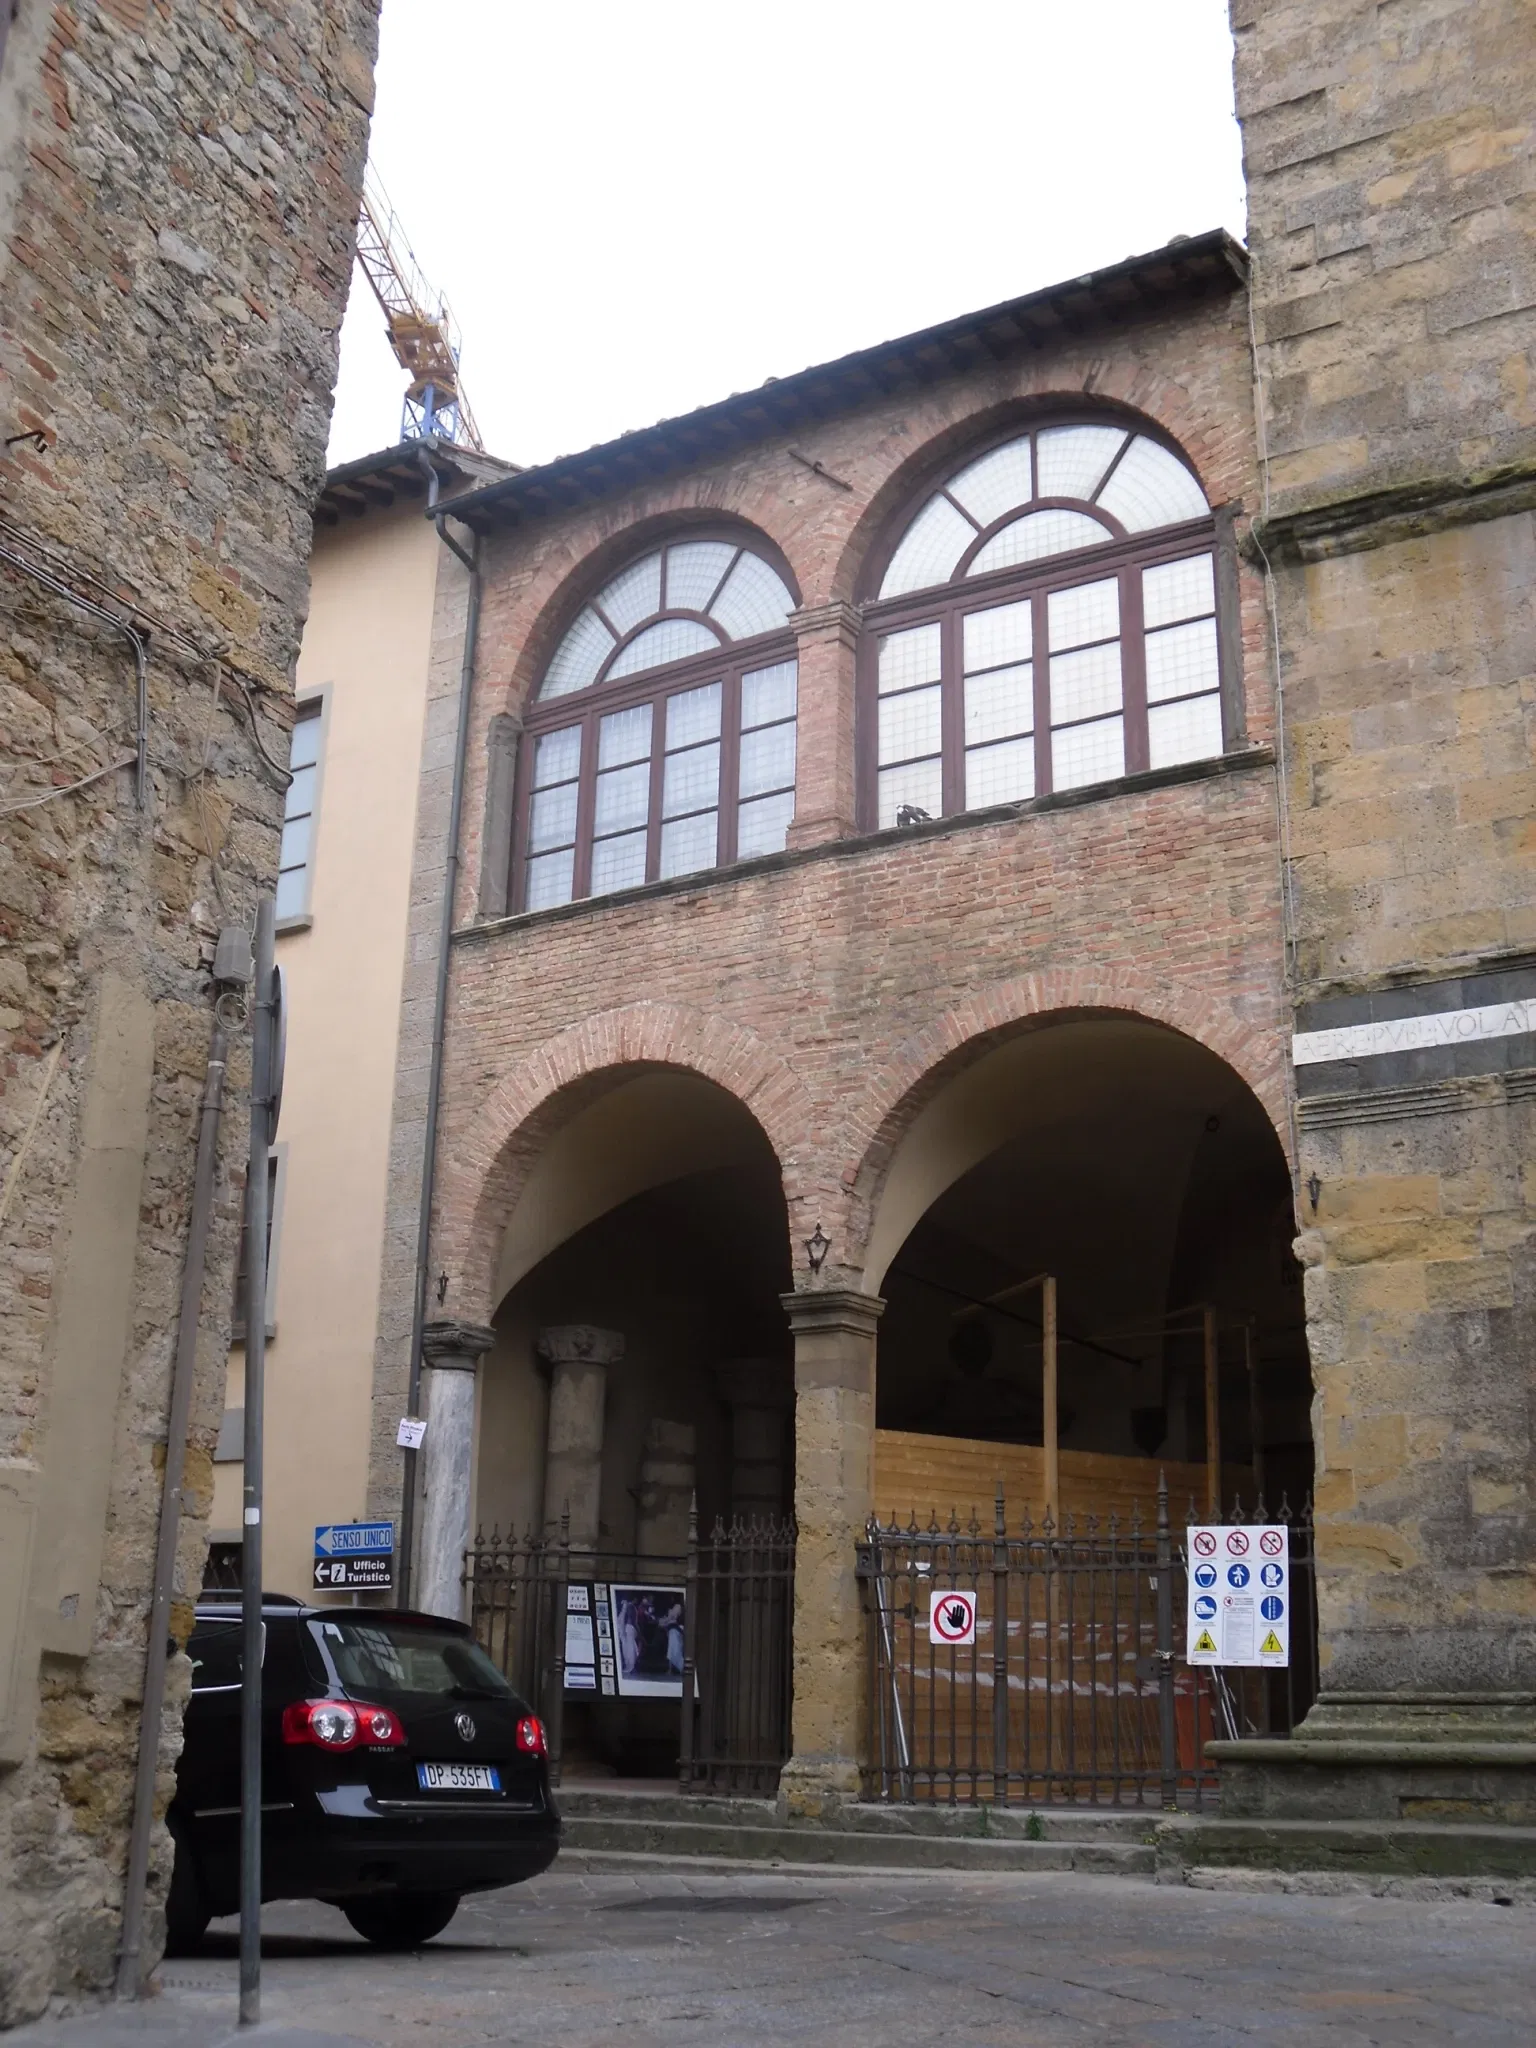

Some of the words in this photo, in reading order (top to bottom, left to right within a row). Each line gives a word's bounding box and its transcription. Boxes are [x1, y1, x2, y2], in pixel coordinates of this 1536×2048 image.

[332, 1531, 360, 1548] SENSO
[364, 1529, 391, 1546] UNICO
[353, 1560, 386, 1571] Ufficio
[347, 1572, 391, 1582] Turistico
